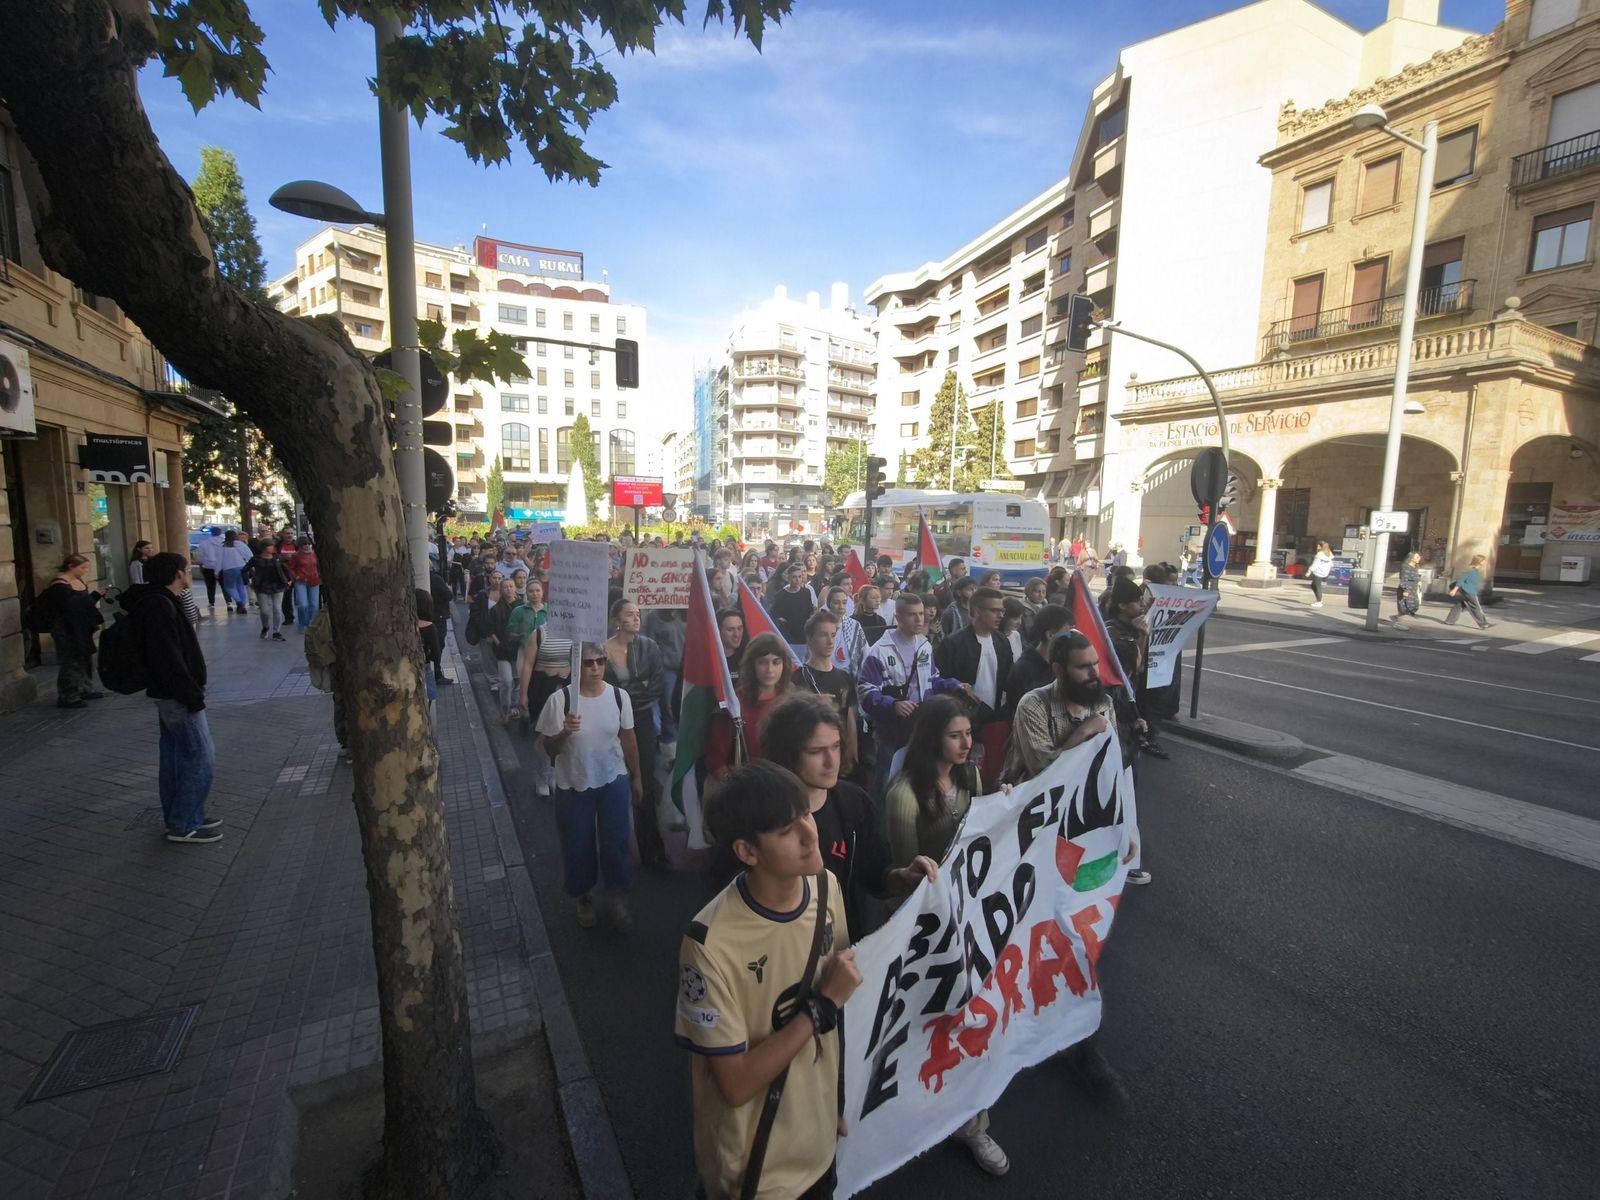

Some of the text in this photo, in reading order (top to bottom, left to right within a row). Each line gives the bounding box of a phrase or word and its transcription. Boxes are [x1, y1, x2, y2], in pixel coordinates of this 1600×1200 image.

[499, 252, 582, 273] CAJA RURAL
[1246, 410, 1312, 434] SERVICIO
[632, 552, 649, 569] NO
[629, 571, 644, 584] ES
[637, 594, 690, 606] DESARMAD
[1172, 598, 1184, 609] 15
